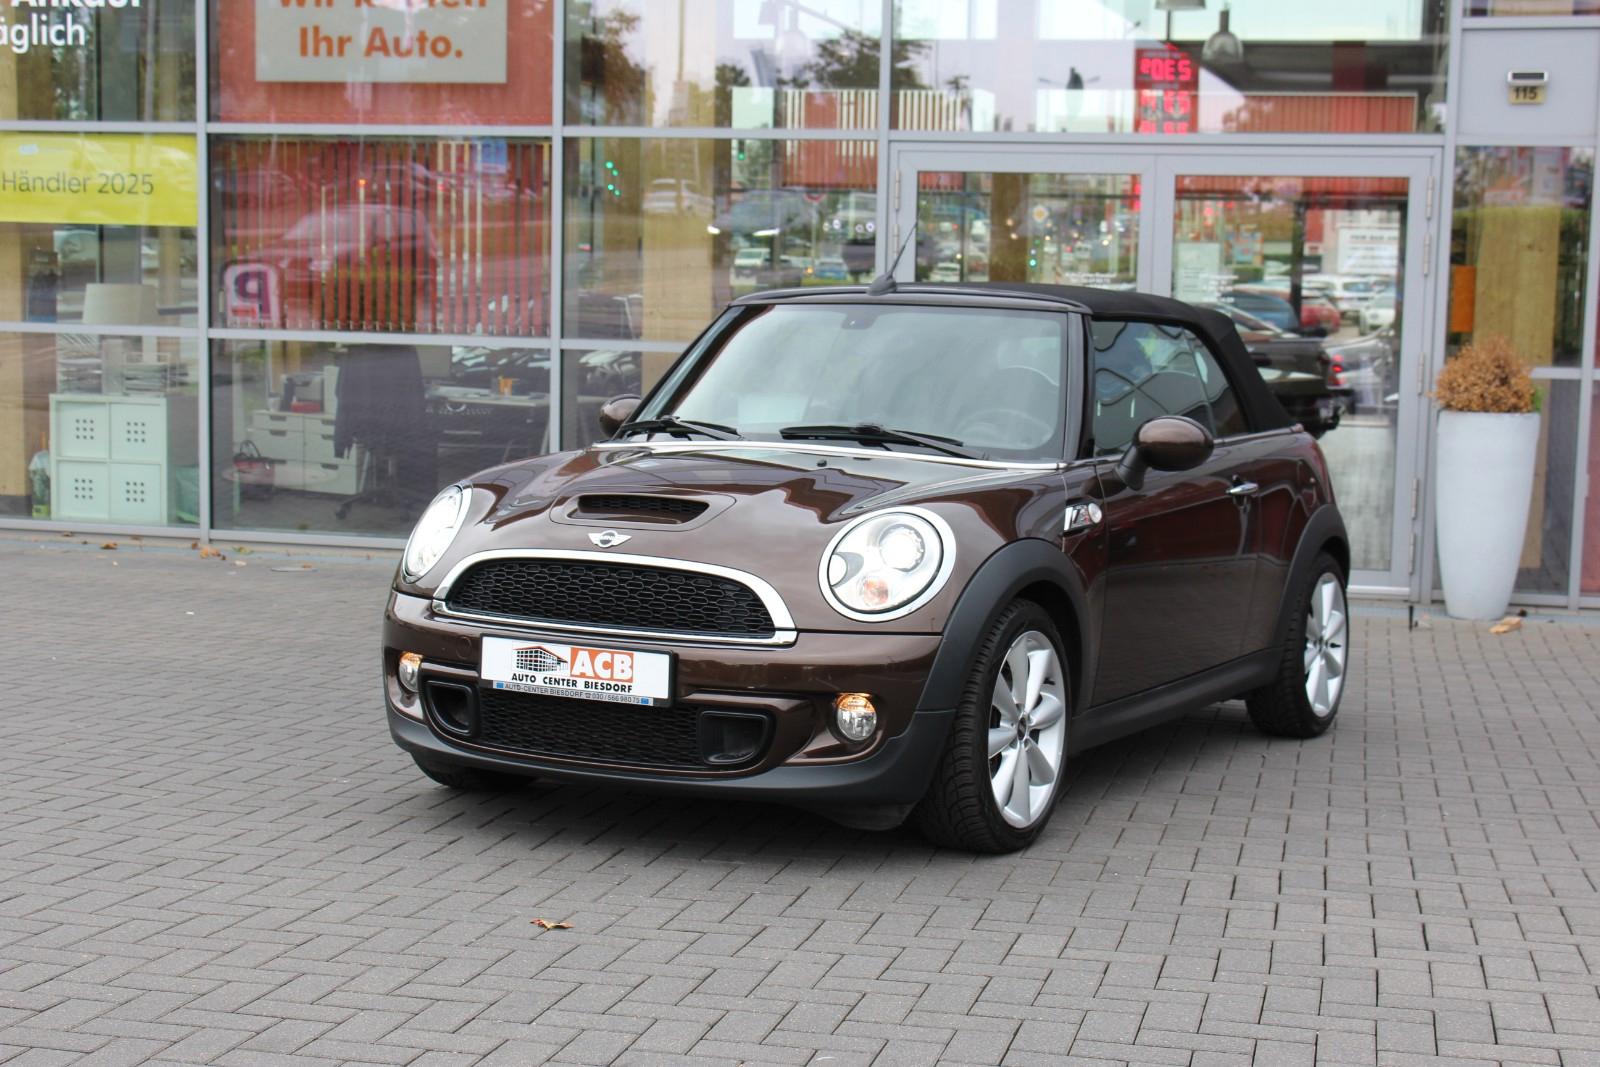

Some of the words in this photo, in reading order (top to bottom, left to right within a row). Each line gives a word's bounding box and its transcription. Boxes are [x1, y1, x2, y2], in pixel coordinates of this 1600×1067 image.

[299, 25, 352, 57] Ihr
[364, 26, 463, 58] Auto.
[1513, 86, 1537, 100] 115
[2, 170, 91, 193] Händler
[97, 172, 154, 195] 2025
[571, 650, 633, 680] ACB
[505, 683, 549, 694] AUTO-CENTER
[549, 689, 583, 698] BIESDORF
[511, 673, 537, 683] AUTO
[542, 676, 578, 688] CENTER
[584, 681, 633, 693] BIESDORF
